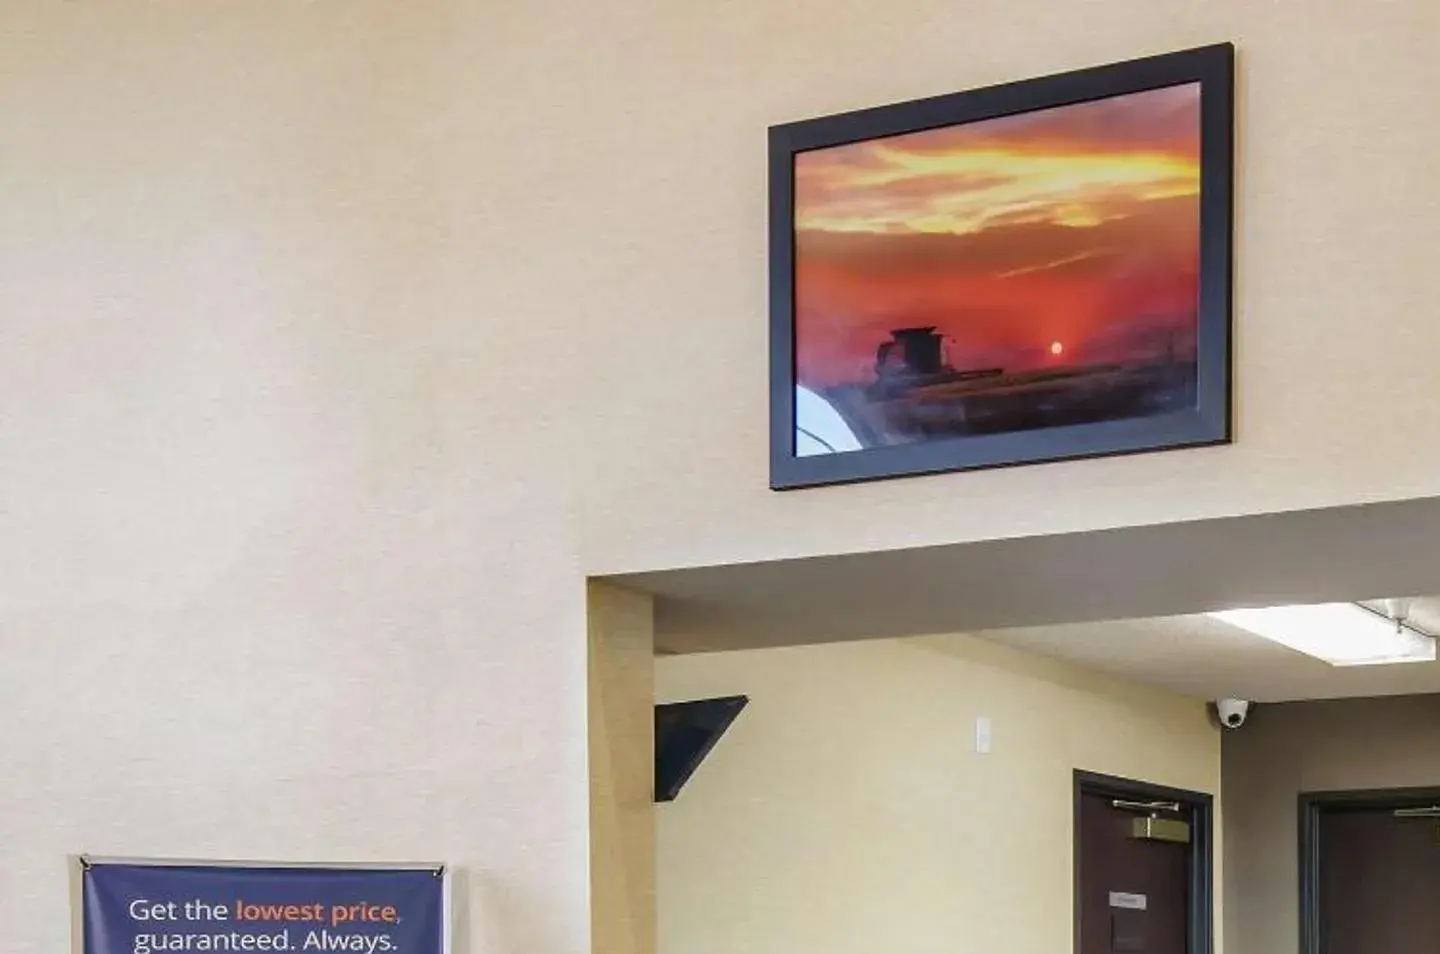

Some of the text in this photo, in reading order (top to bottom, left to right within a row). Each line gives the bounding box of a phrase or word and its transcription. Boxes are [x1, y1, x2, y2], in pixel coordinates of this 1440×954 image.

[130, 898, 400, 927] Get the lowest price,
